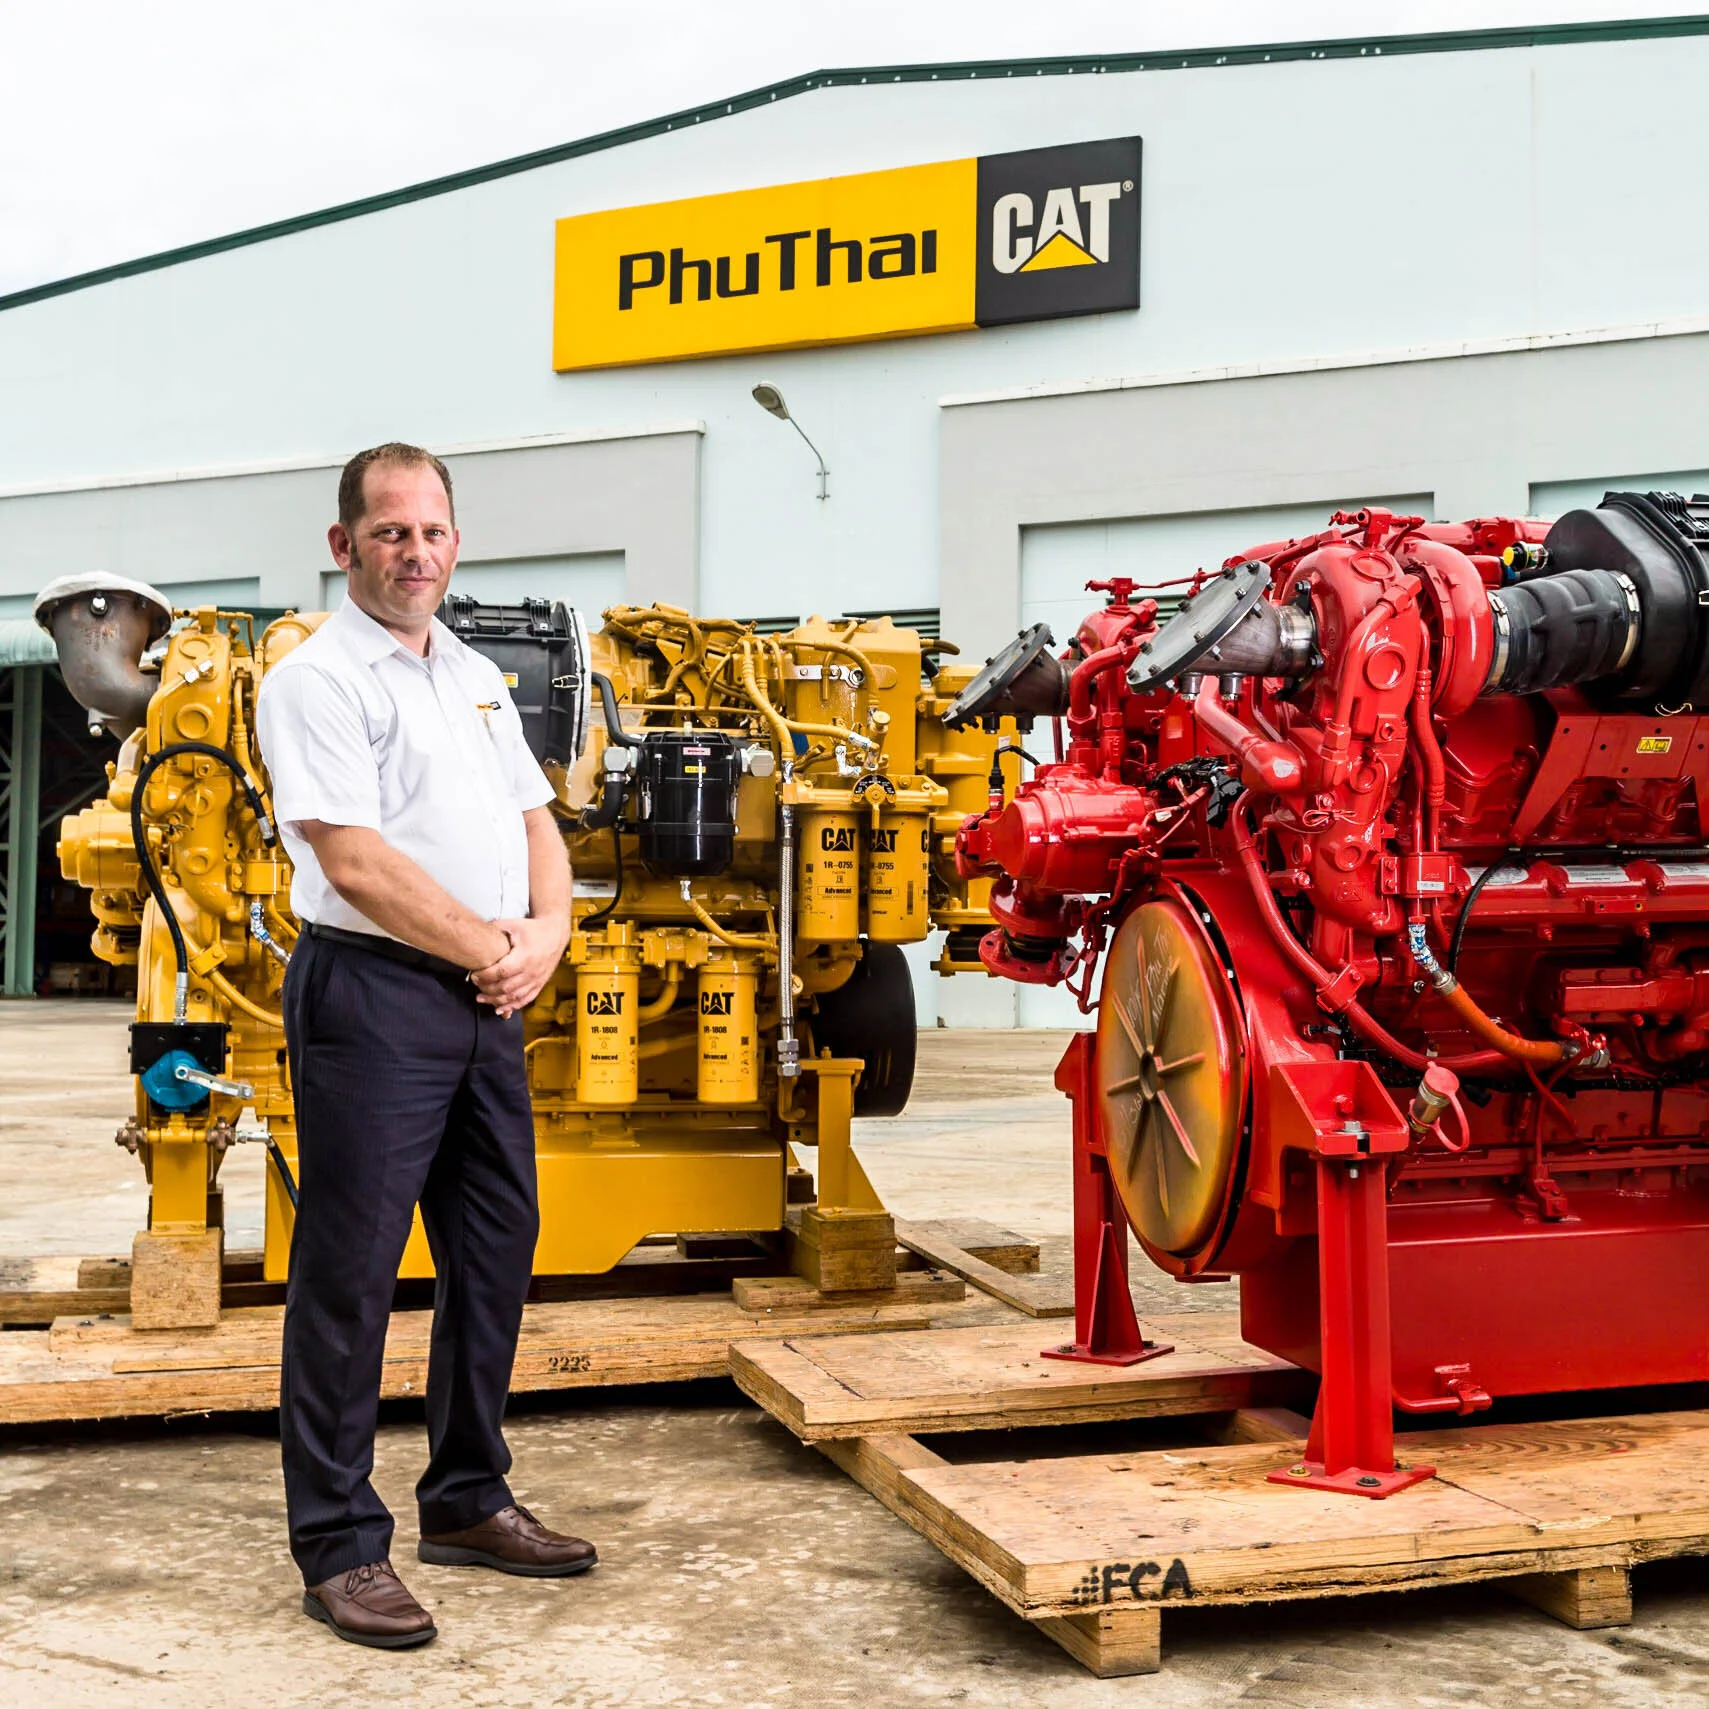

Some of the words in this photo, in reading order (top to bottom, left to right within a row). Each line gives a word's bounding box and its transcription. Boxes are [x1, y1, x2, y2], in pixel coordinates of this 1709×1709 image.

[993, 181, 1121, 274] CAT
[618, 227, 937, 311] PhuThai
[821, 827, 856, 852] CAT
[823, 861, 854, 869] 1R-0755
[824, 887, 852, 895] Advanced
[586, 991, 625, 1016] CAT
[700, 991, 735, 1016] CAT
[548, 1356, 591, 1373] 2225
[1102, 1557, 1194, 1604] FCA
